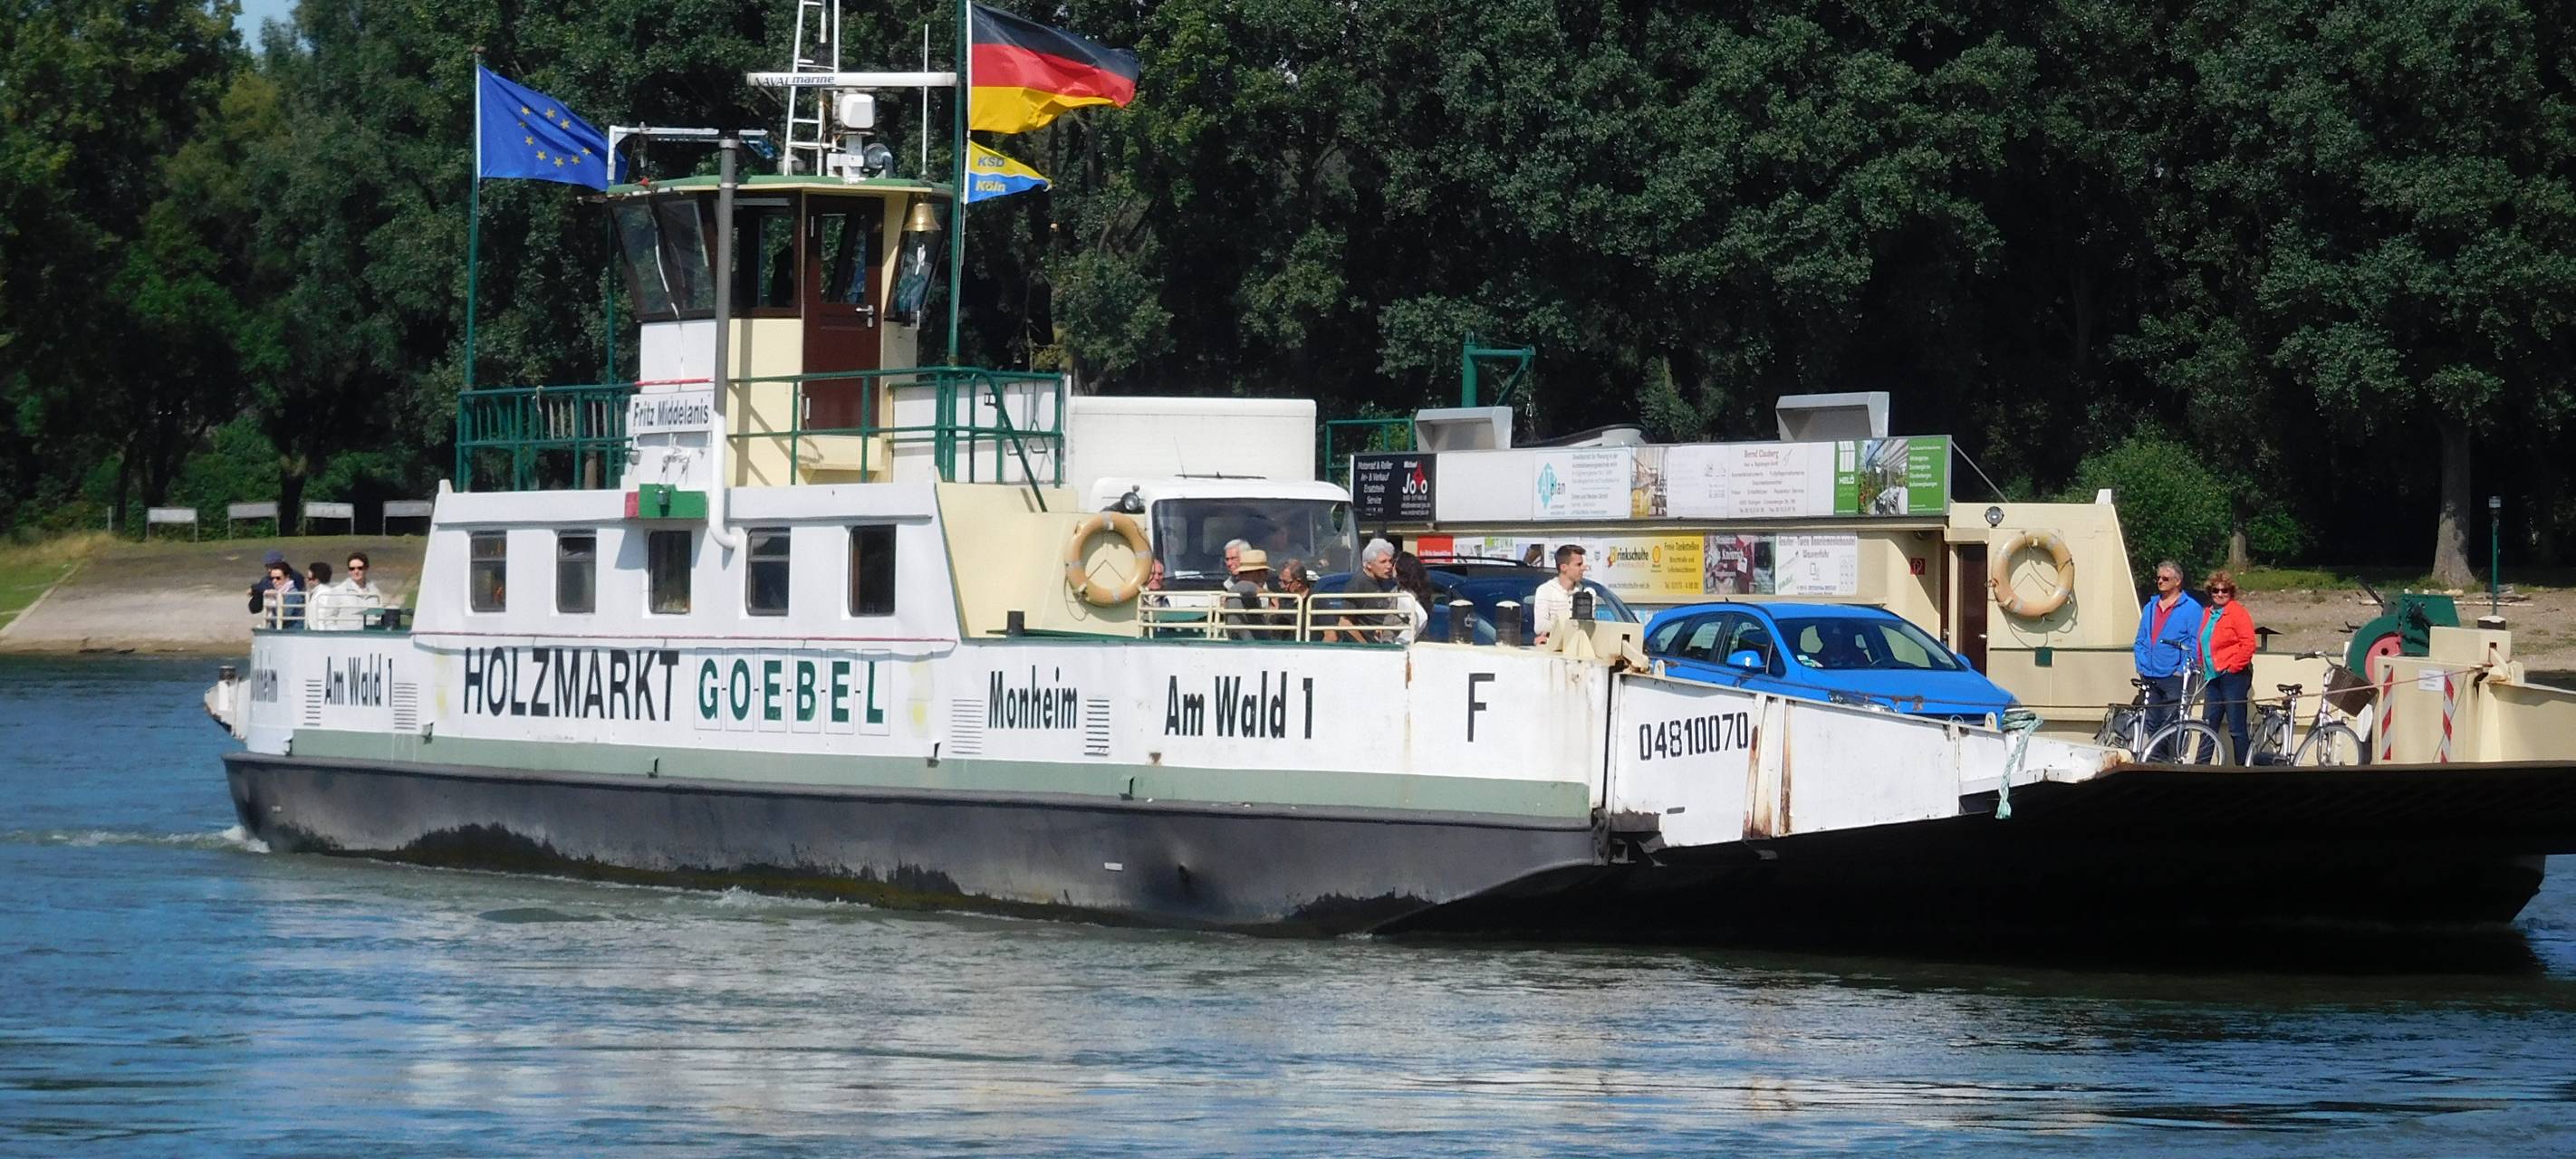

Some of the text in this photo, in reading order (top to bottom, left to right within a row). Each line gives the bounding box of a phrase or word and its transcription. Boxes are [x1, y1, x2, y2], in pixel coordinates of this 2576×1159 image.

[792, 75, 834, 84] marine
[976, 180, 1006, 192] Köln
[979, 156, 1005, 167] KSD
[634, 398, 709, 427] Fritz Middelanis
[324, 653, 393, 707] Am Wald 1
[464, 647, 679, 721] HOLZMARKT
[988, 666, 1078, 729] Monheim
[1165, 671, 1313, 739] Am Wald 1
[1467, 673, 1495, 742] F
[1639, 712, 1748, 761] 04810070
